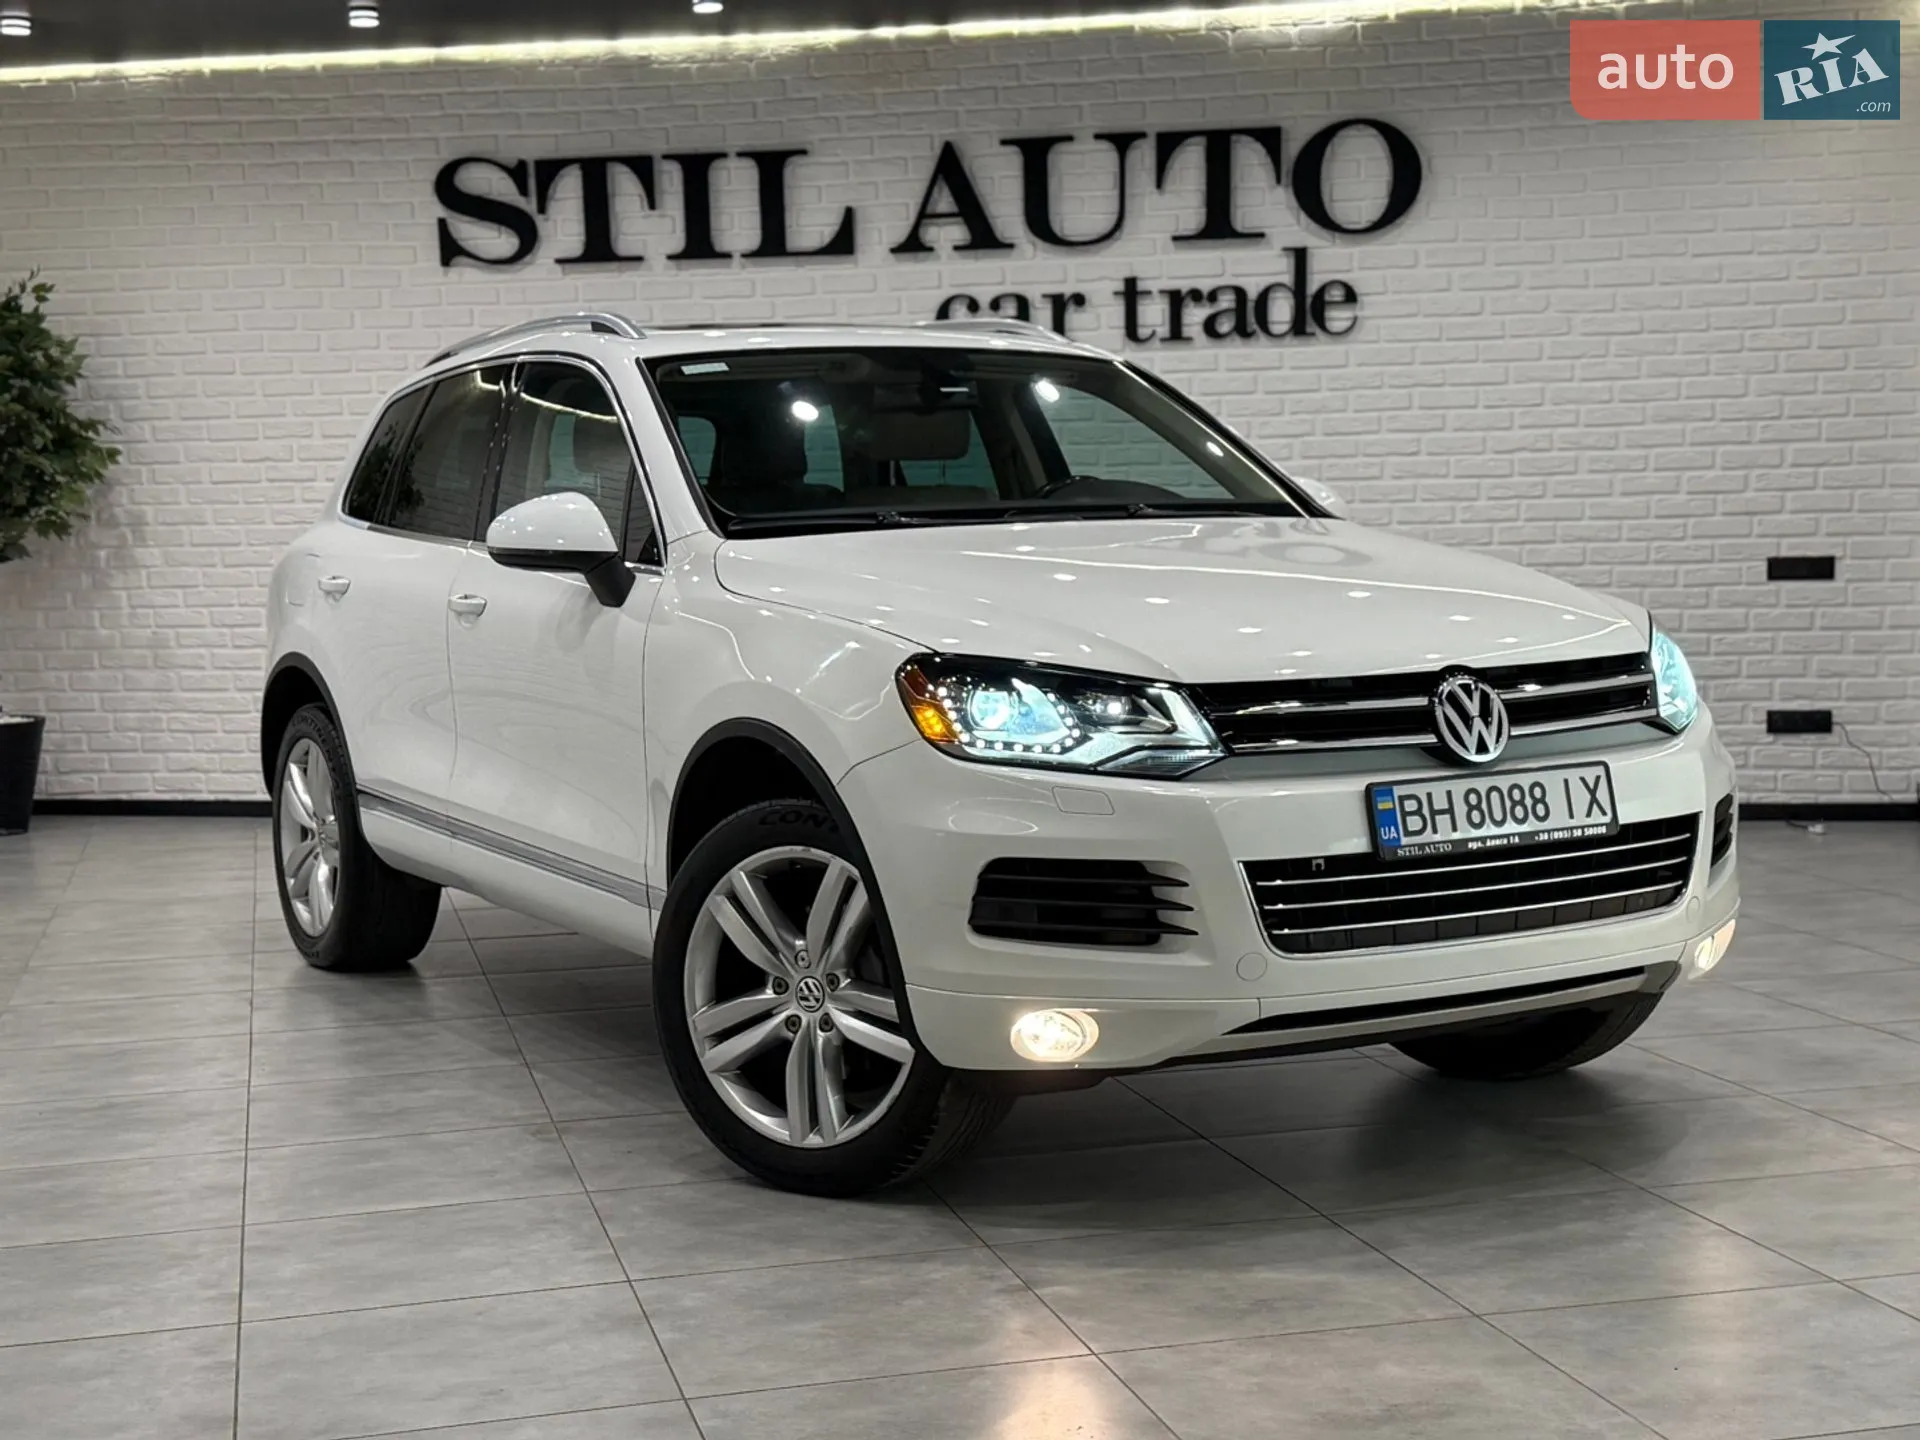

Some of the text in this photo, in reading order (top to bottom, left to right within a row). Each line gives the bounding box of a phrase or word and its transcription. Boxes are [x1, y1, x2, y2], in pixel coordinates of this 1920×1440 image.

[433, 117, 1423, 268] STIL AUTO
[1112, 246, 1360, 344] trade
[1380, 825, 1399, 840] UA
[1397, 788, 1459, 838] BH
[1463, 780, 1551, 831] 8088
[1397, 842, 1452, 857] STIL AUTO
